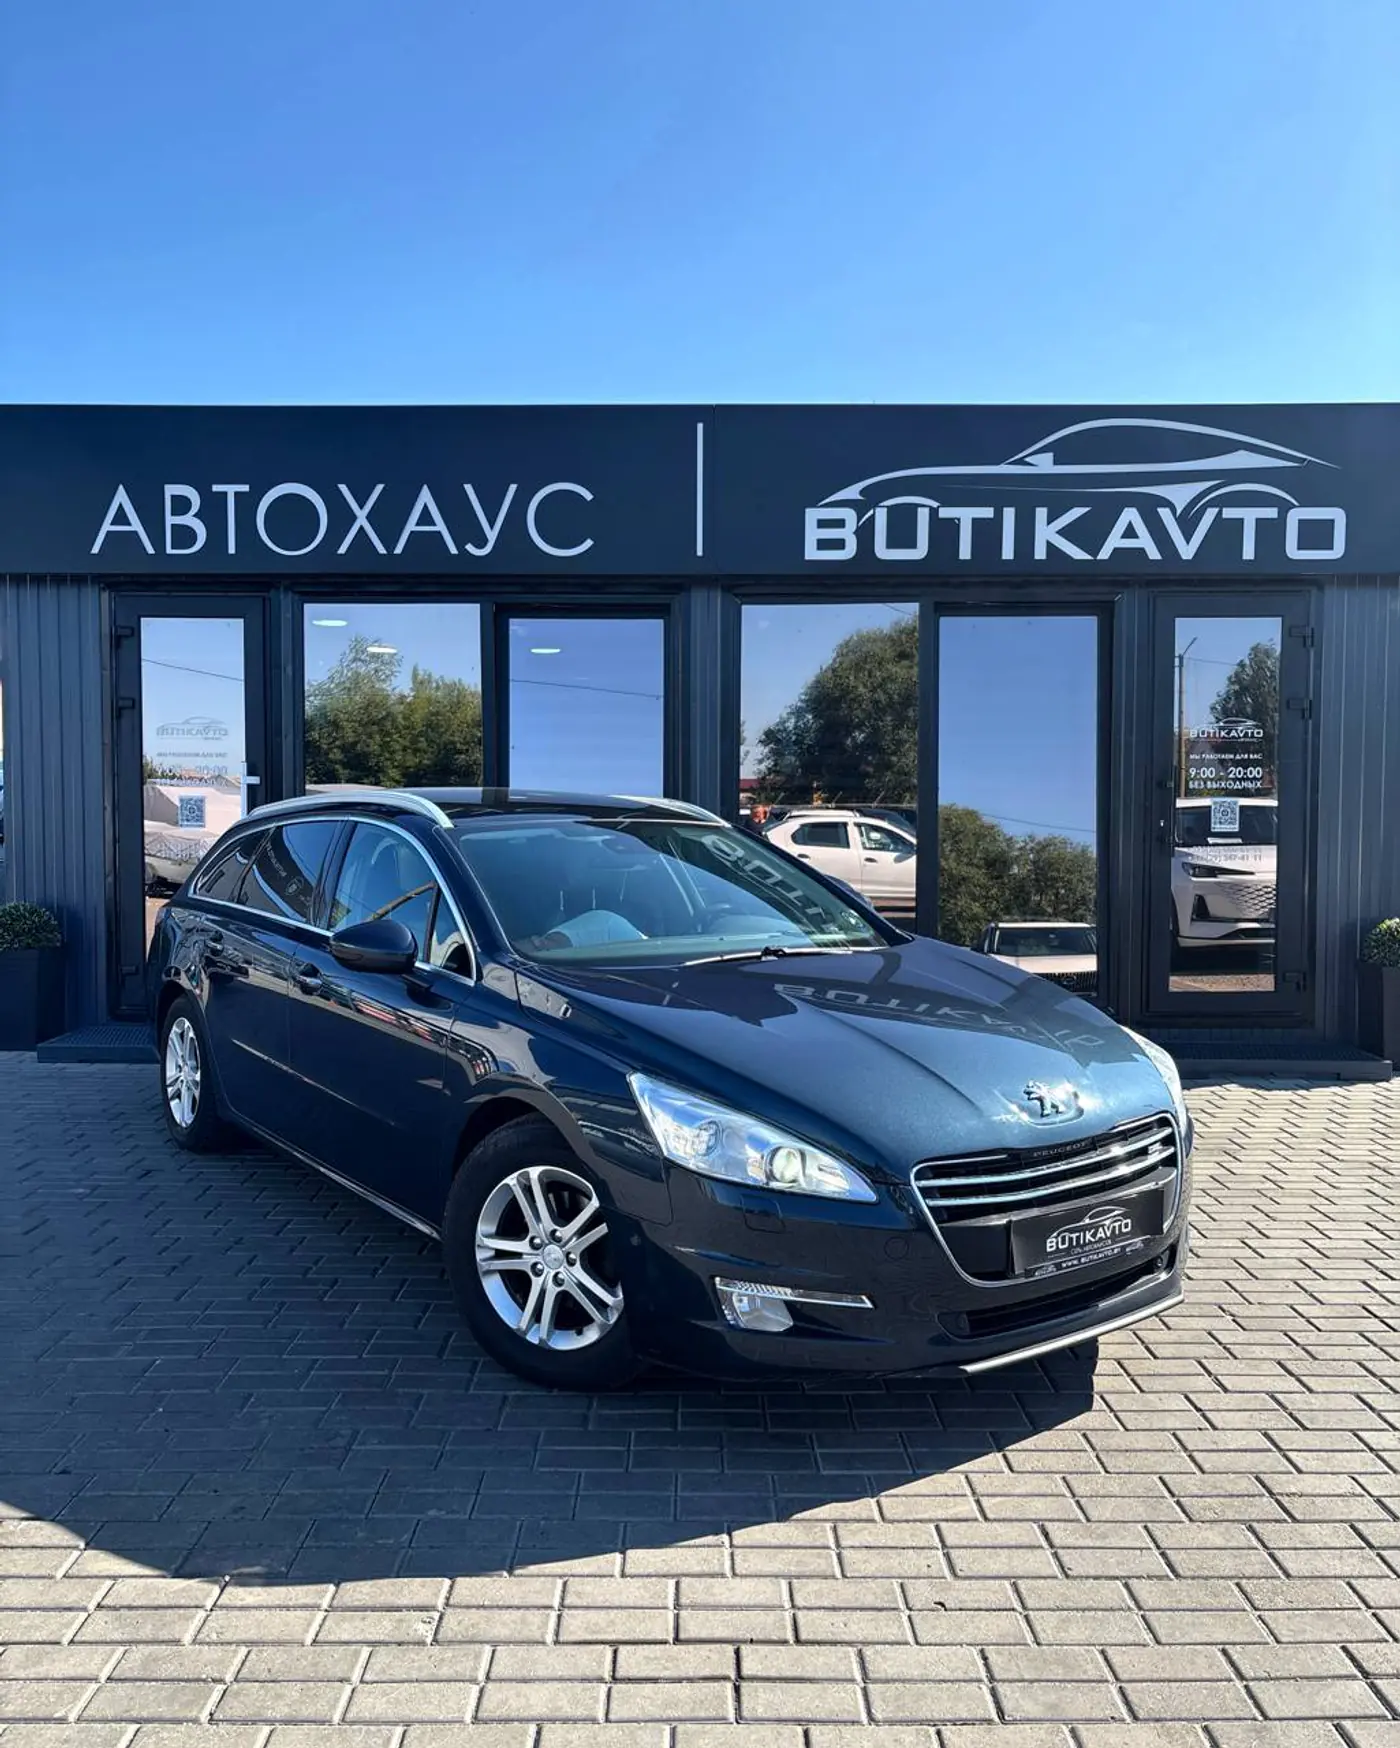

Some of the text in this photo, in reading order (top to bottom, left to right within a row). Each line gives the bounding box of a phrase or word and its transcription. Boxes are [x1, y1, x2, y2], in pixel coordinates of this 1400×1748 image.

[90, 482, 594, 557] АВТОХАУС
[804, 506, 1347, 561] BUTIKAVTO
[1189, 728, 1264, 738] BUTIKAVTO
[1189, 767, 1216, 779] 9:00
[1227, 766, 1263, 779] 20:00
[1188, 779, 1262, 790] БЕЗ ВЫХОДНЫХ
[1033, 1142, 1086, 1157] PEUGEOT
[1046, 1218, 1132, 1253] BUTIKAVTO
